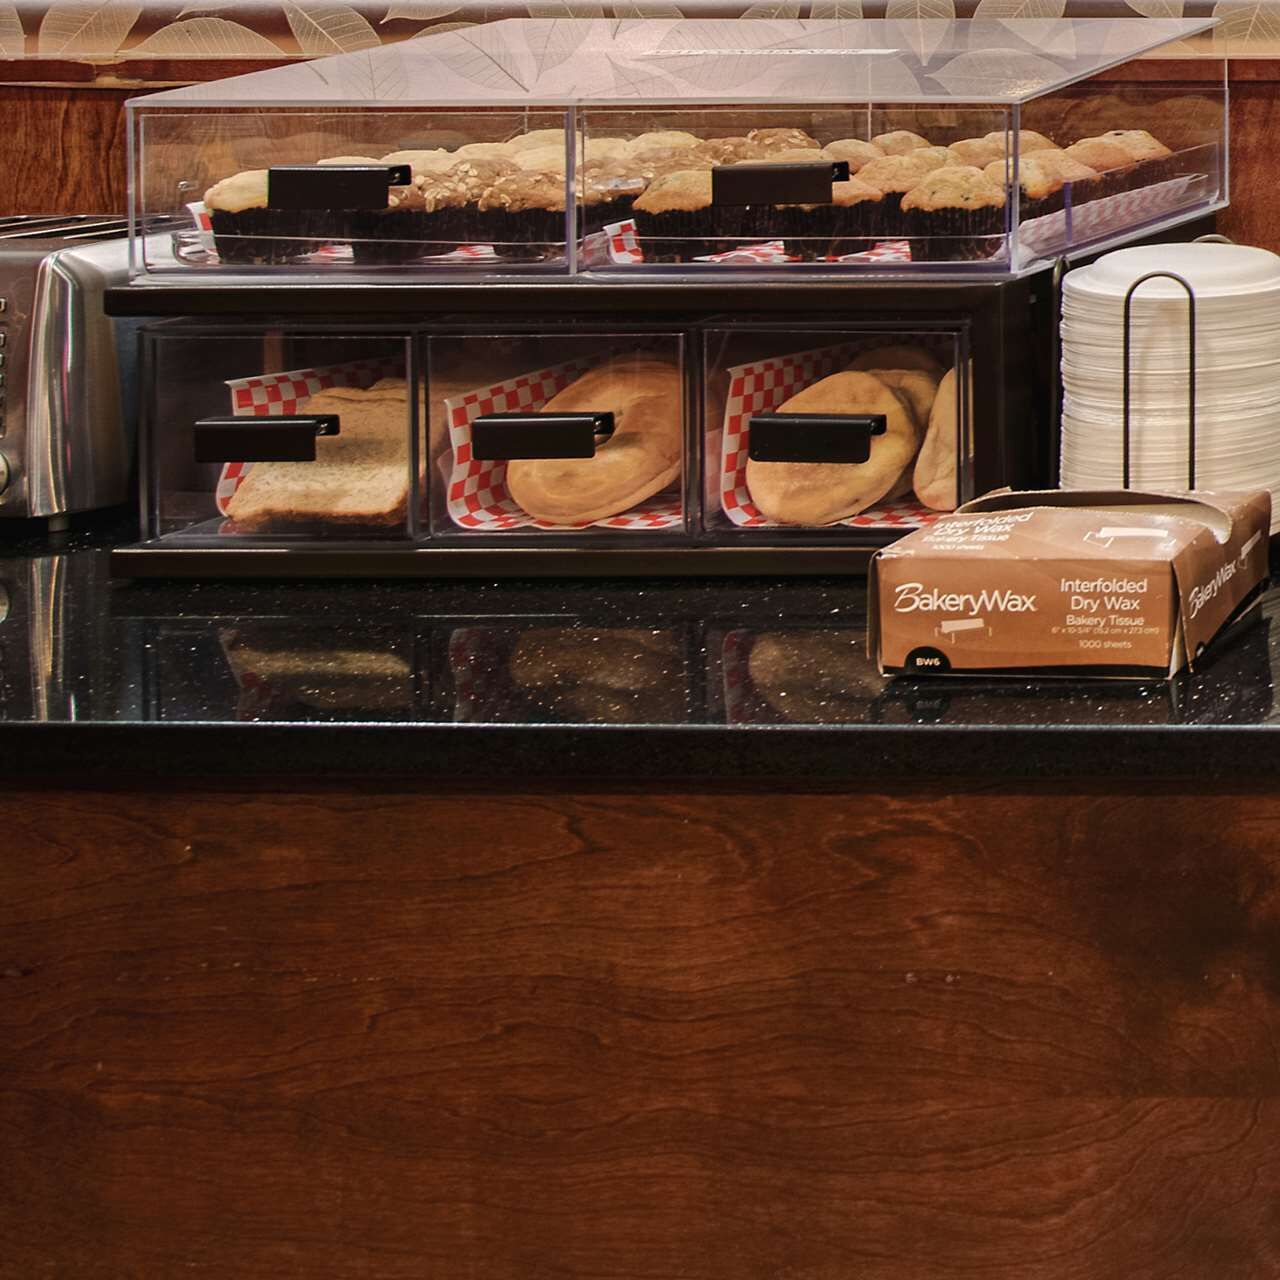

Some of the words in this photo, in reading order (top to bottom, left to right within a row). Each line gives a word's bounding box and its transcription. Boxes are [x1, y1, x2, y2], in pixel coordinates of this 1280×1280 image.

[933, 511, 1034, 530] Interfolded
[1060, 577, 1149, 593] Interfolded
[894, 582, 1039, 616] BakeryWax
[1071, 595, 1101, 613] Dry
[1103, 596, 1141, 611] Wax
[1065, 614, 1107, 627] Bakery
[1108, 614, 1145, 626] Tissue
[1079, 639, 1101, 649] 1000
[1103, 639, 1133, 649] sheets
[915, 657, 941, 667] BW6
